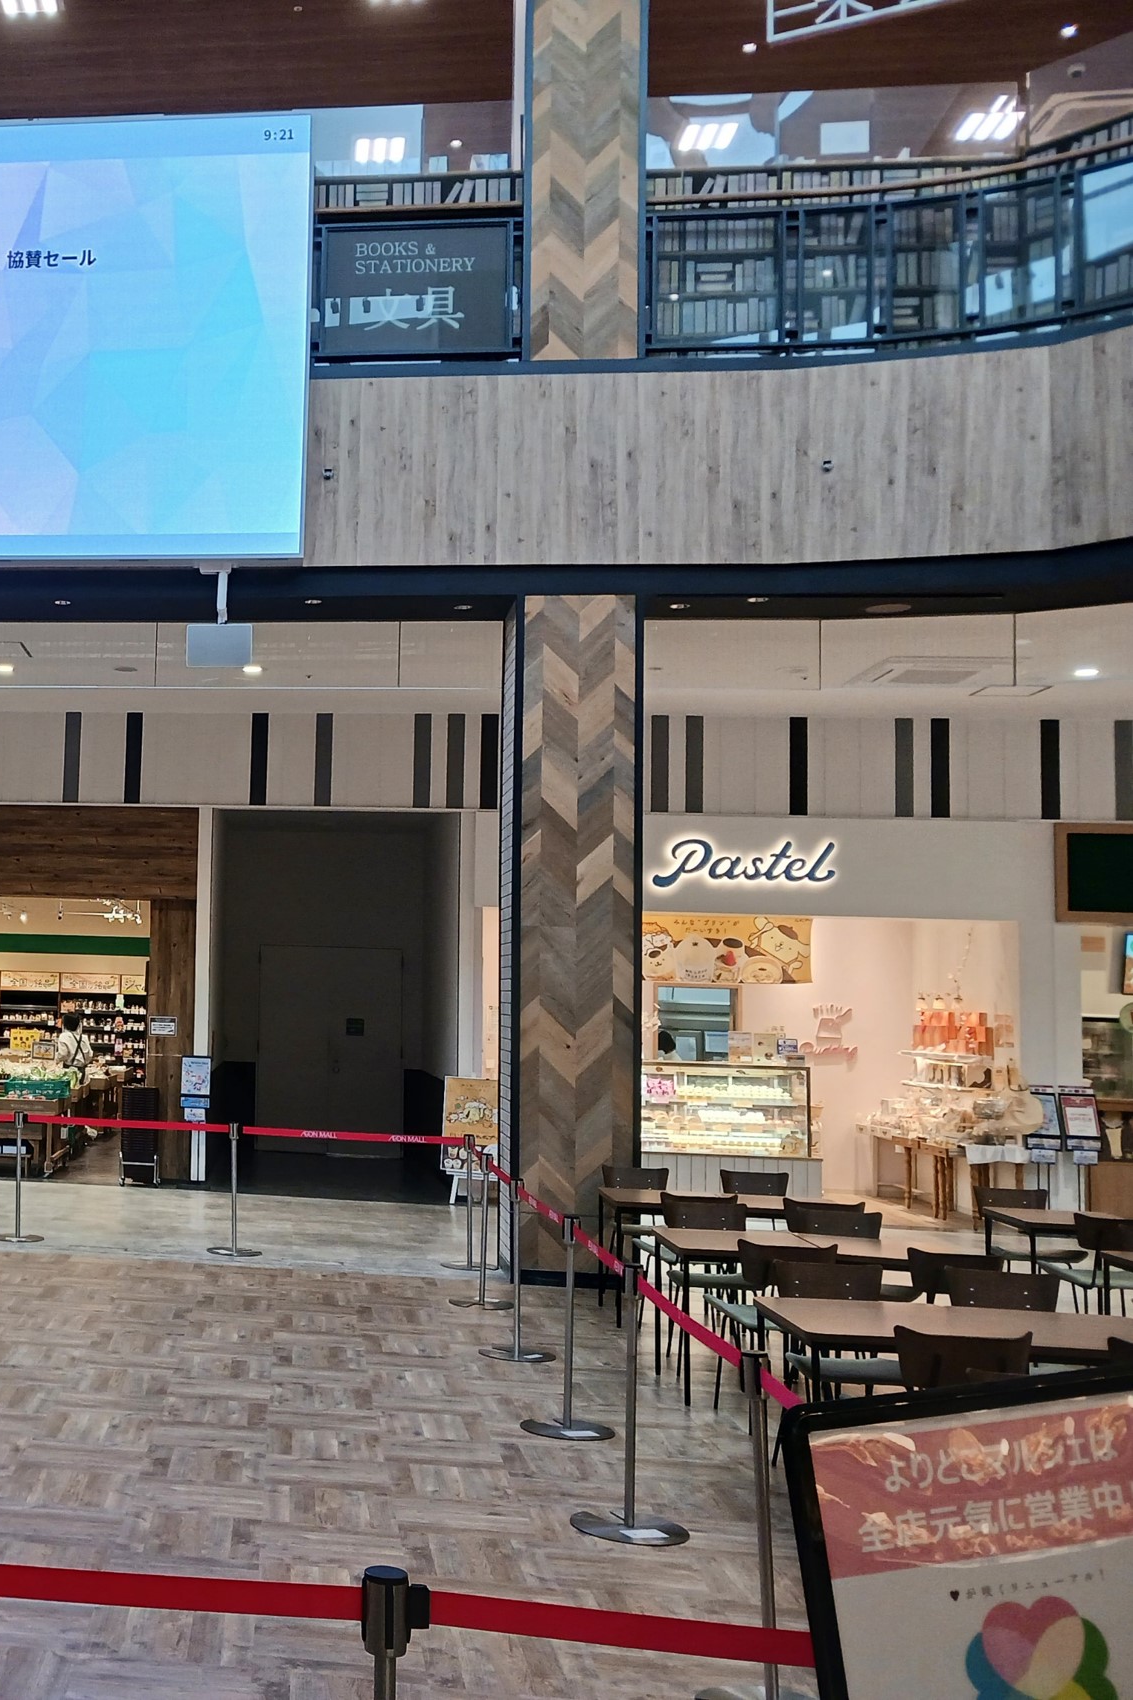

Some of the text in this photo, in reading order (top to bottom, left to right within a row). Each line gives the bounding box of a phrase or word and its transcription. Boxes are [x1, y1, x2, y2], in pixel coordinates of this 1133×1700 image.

[263, 128, 295, 141] 9:21
[355, 241, 437, 258] BOOKS &
[6, 249, 97, 269] 協賛セール
[355, 257, 476, 275] STATIONERY
[652, 839, 836, 888] Pastel
[319, 1131, 338, 1139] MALL
[407, 1135, 426, 1143] MALL
[858, 1480, 1133, 1553] 全店元気に営業中
